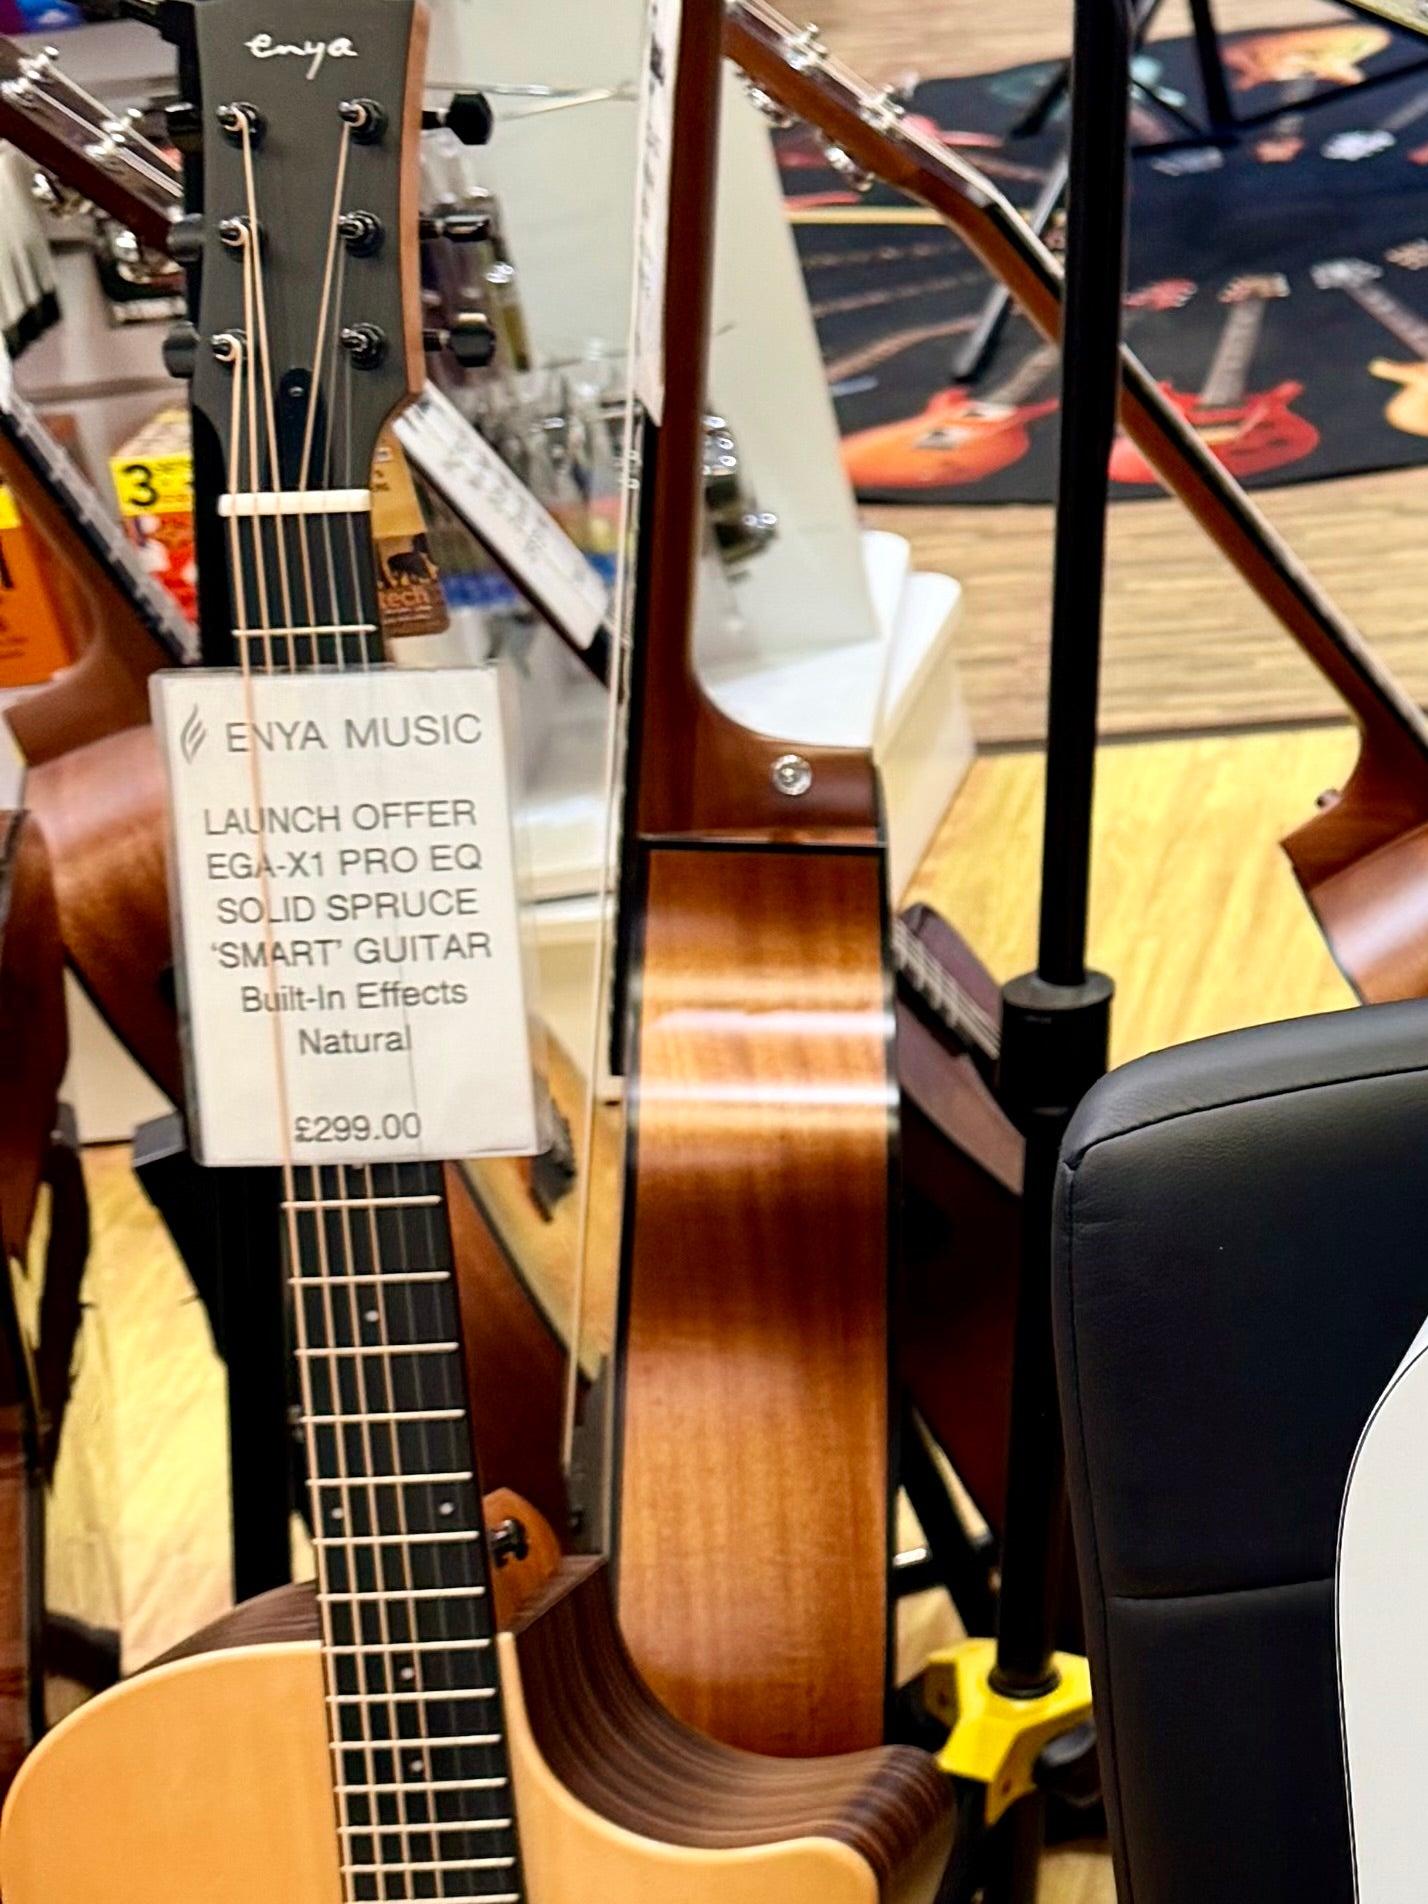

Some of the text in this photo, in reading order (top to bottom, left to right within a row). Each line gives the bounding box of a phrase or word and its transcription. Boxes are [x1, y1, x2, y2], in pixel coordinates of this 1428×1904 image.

[243, 33, 360, 81] enya
[122, 463, 158, 508] 3
[225, 712, 483, 754] ENYA MUSIC
[203, 798, 478, 837] LAUNCH OFFER
[205, 842, 483, 881] EGA-X1 PRO EQ
[216, 888, 480, 925] SOLID SPRUCE
[353, 932, 493, 965] GUITAR
[241, 980, 469, 1013] Built-In Effects
[299, 1024, 412, 1056] Natural
[295, 1112, 422, 1143] £299.00
